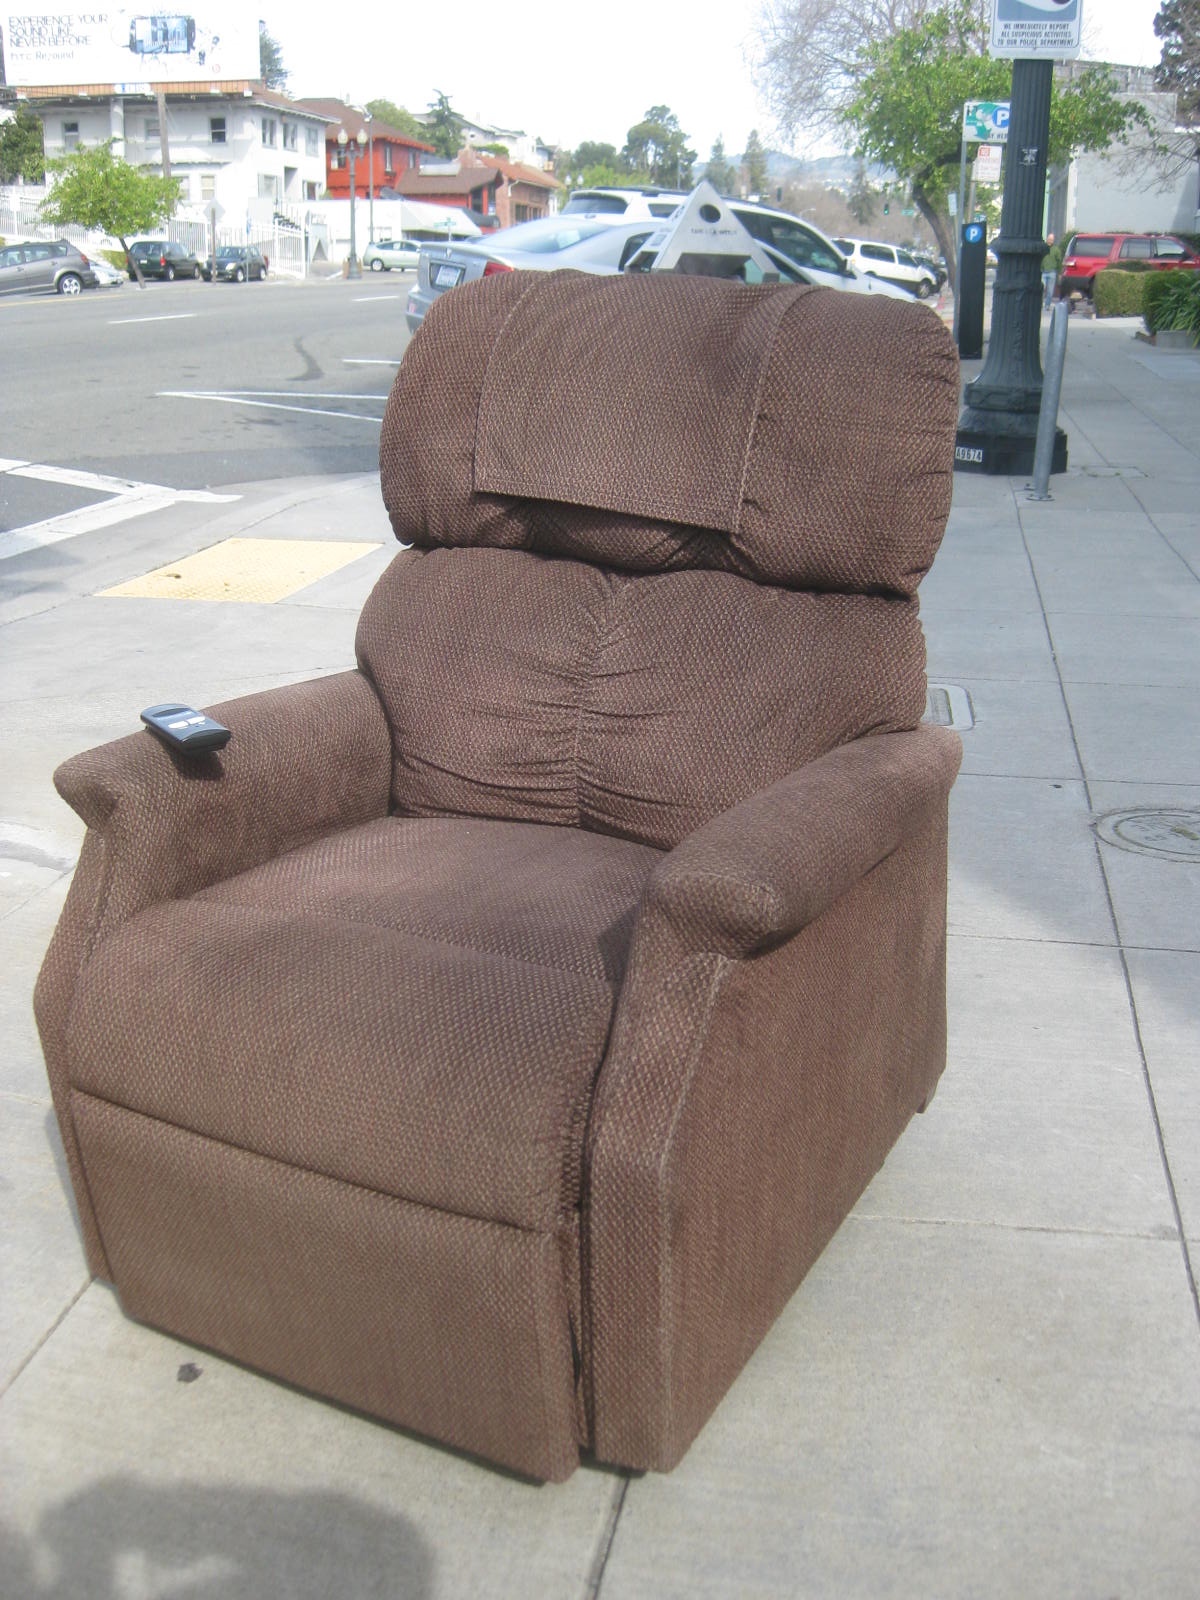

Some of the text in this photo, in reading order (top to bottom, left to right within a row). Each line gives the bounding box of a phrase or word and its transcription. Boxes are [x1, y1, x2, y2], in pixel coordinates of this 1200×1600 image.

[9, 13, 108, 26] EXPERIENCE YOUR
[9, 25, 74, 37] SOUND LIKE
[10, 35, 91, 48] NEVER BEFORE
[1020, 39, 1038, 47] POLICE
[1040, 39, 1074, 47] DEPARTMENT
